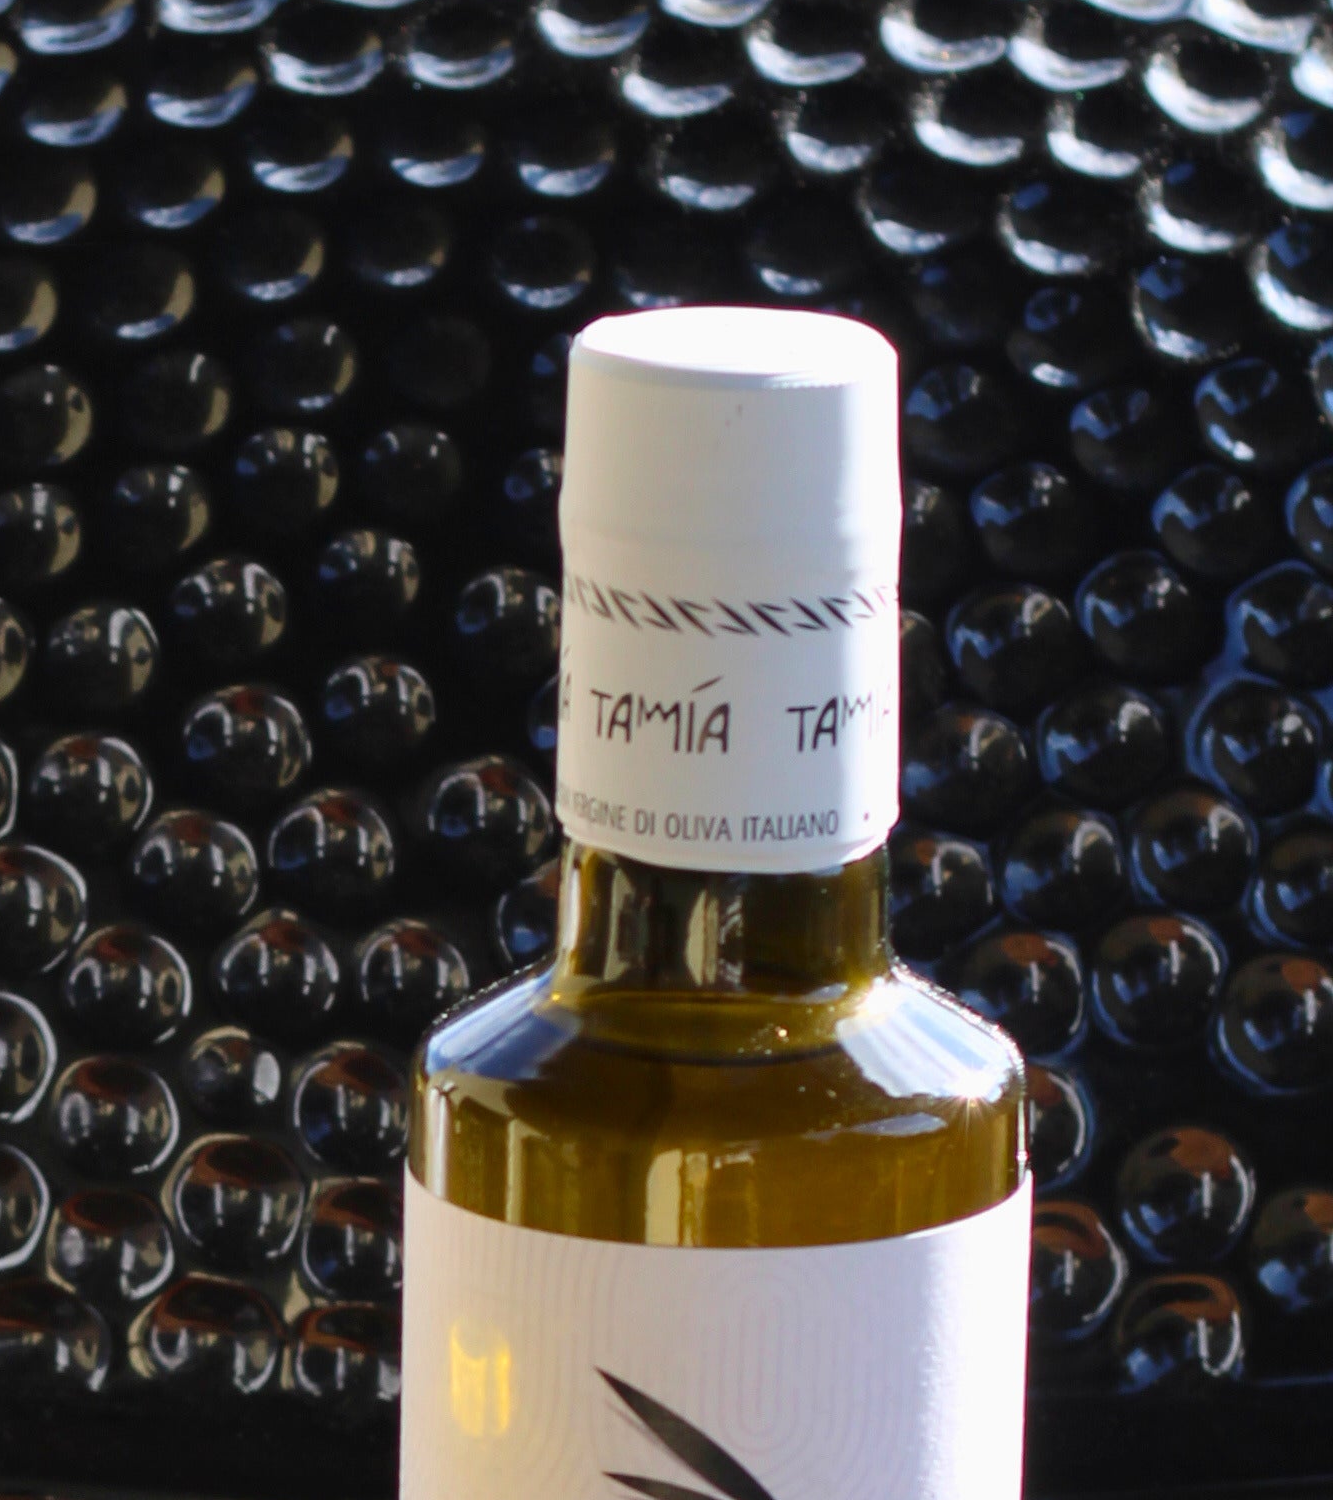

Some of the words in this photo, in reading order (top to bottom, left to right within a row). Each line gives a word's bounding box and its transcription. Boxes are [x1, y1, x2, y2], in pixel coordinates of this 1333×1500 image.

[590, 674, 731, 754] TAMÍA
[634, 807, 657, 837] DI
[664, 811, 733, 842] OLIVA
[741, 808, 841, 843] ITALIANO
